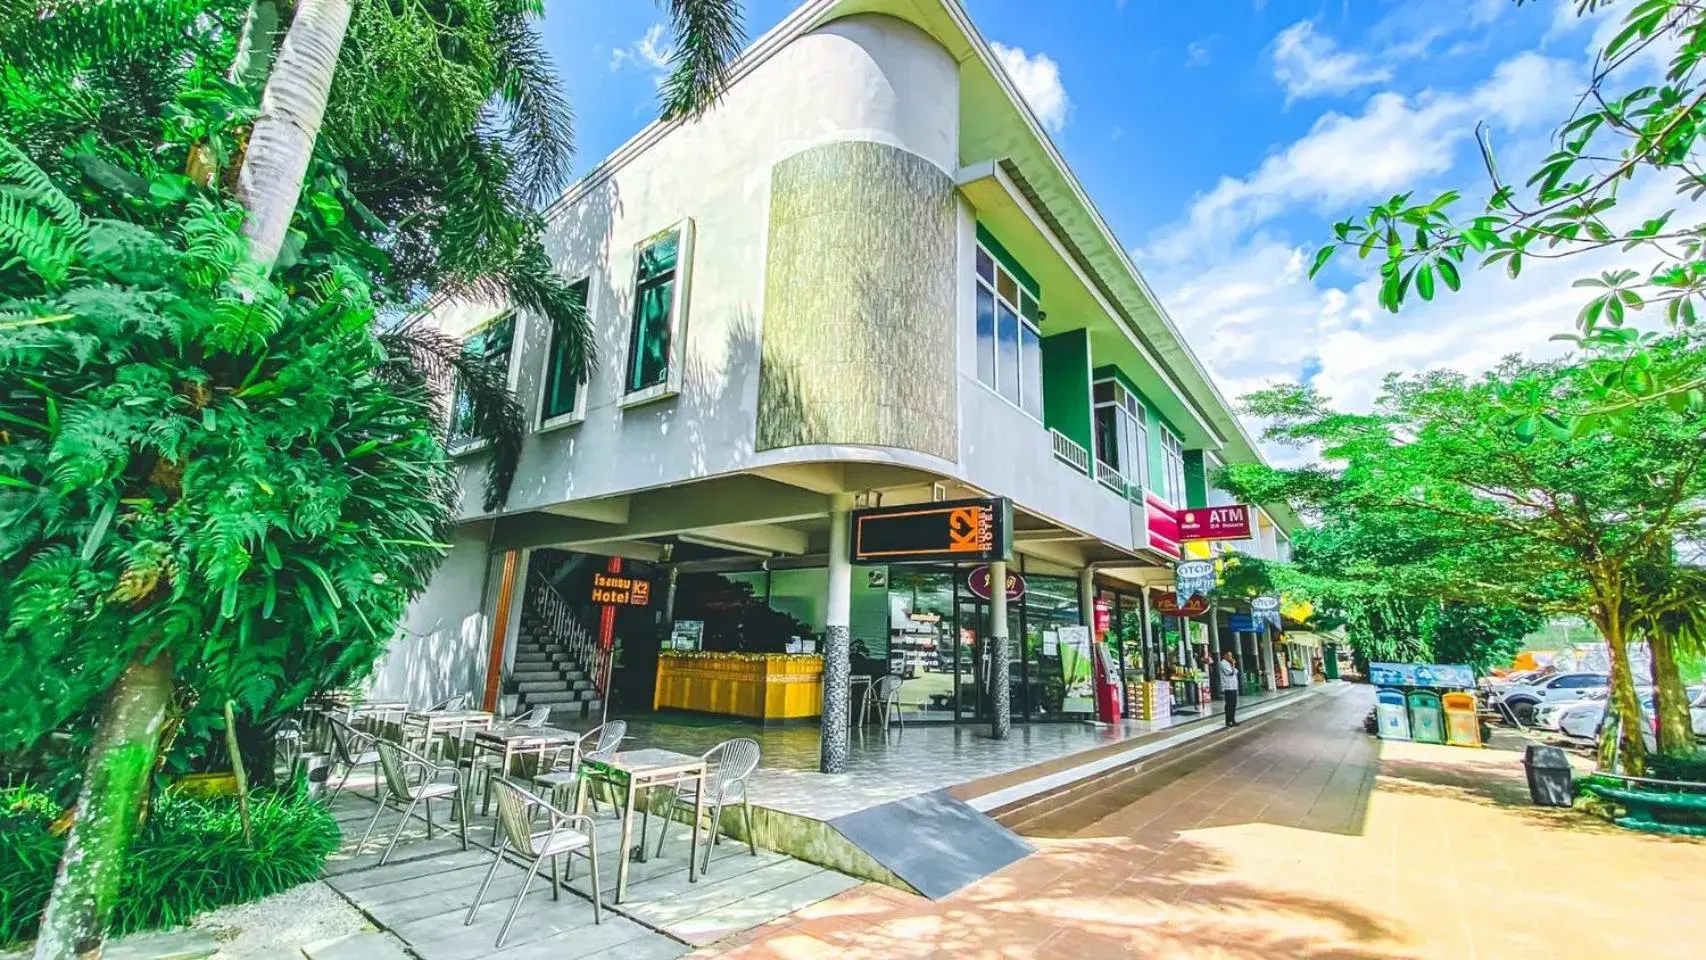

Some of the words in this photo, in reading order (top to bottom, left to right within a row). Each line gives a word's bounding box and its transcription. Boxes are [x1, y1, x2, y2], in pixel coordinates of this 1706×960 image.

[1210, 508, 1244, 523] ATM
[950, 506, 978, 552] K2
[985, 505, 993, 551] HOTEL
[1178, 564, 1211, 575] OTOP
[633, 580, 648, 595] K2
[592, 588, 630, 603] Hotel
